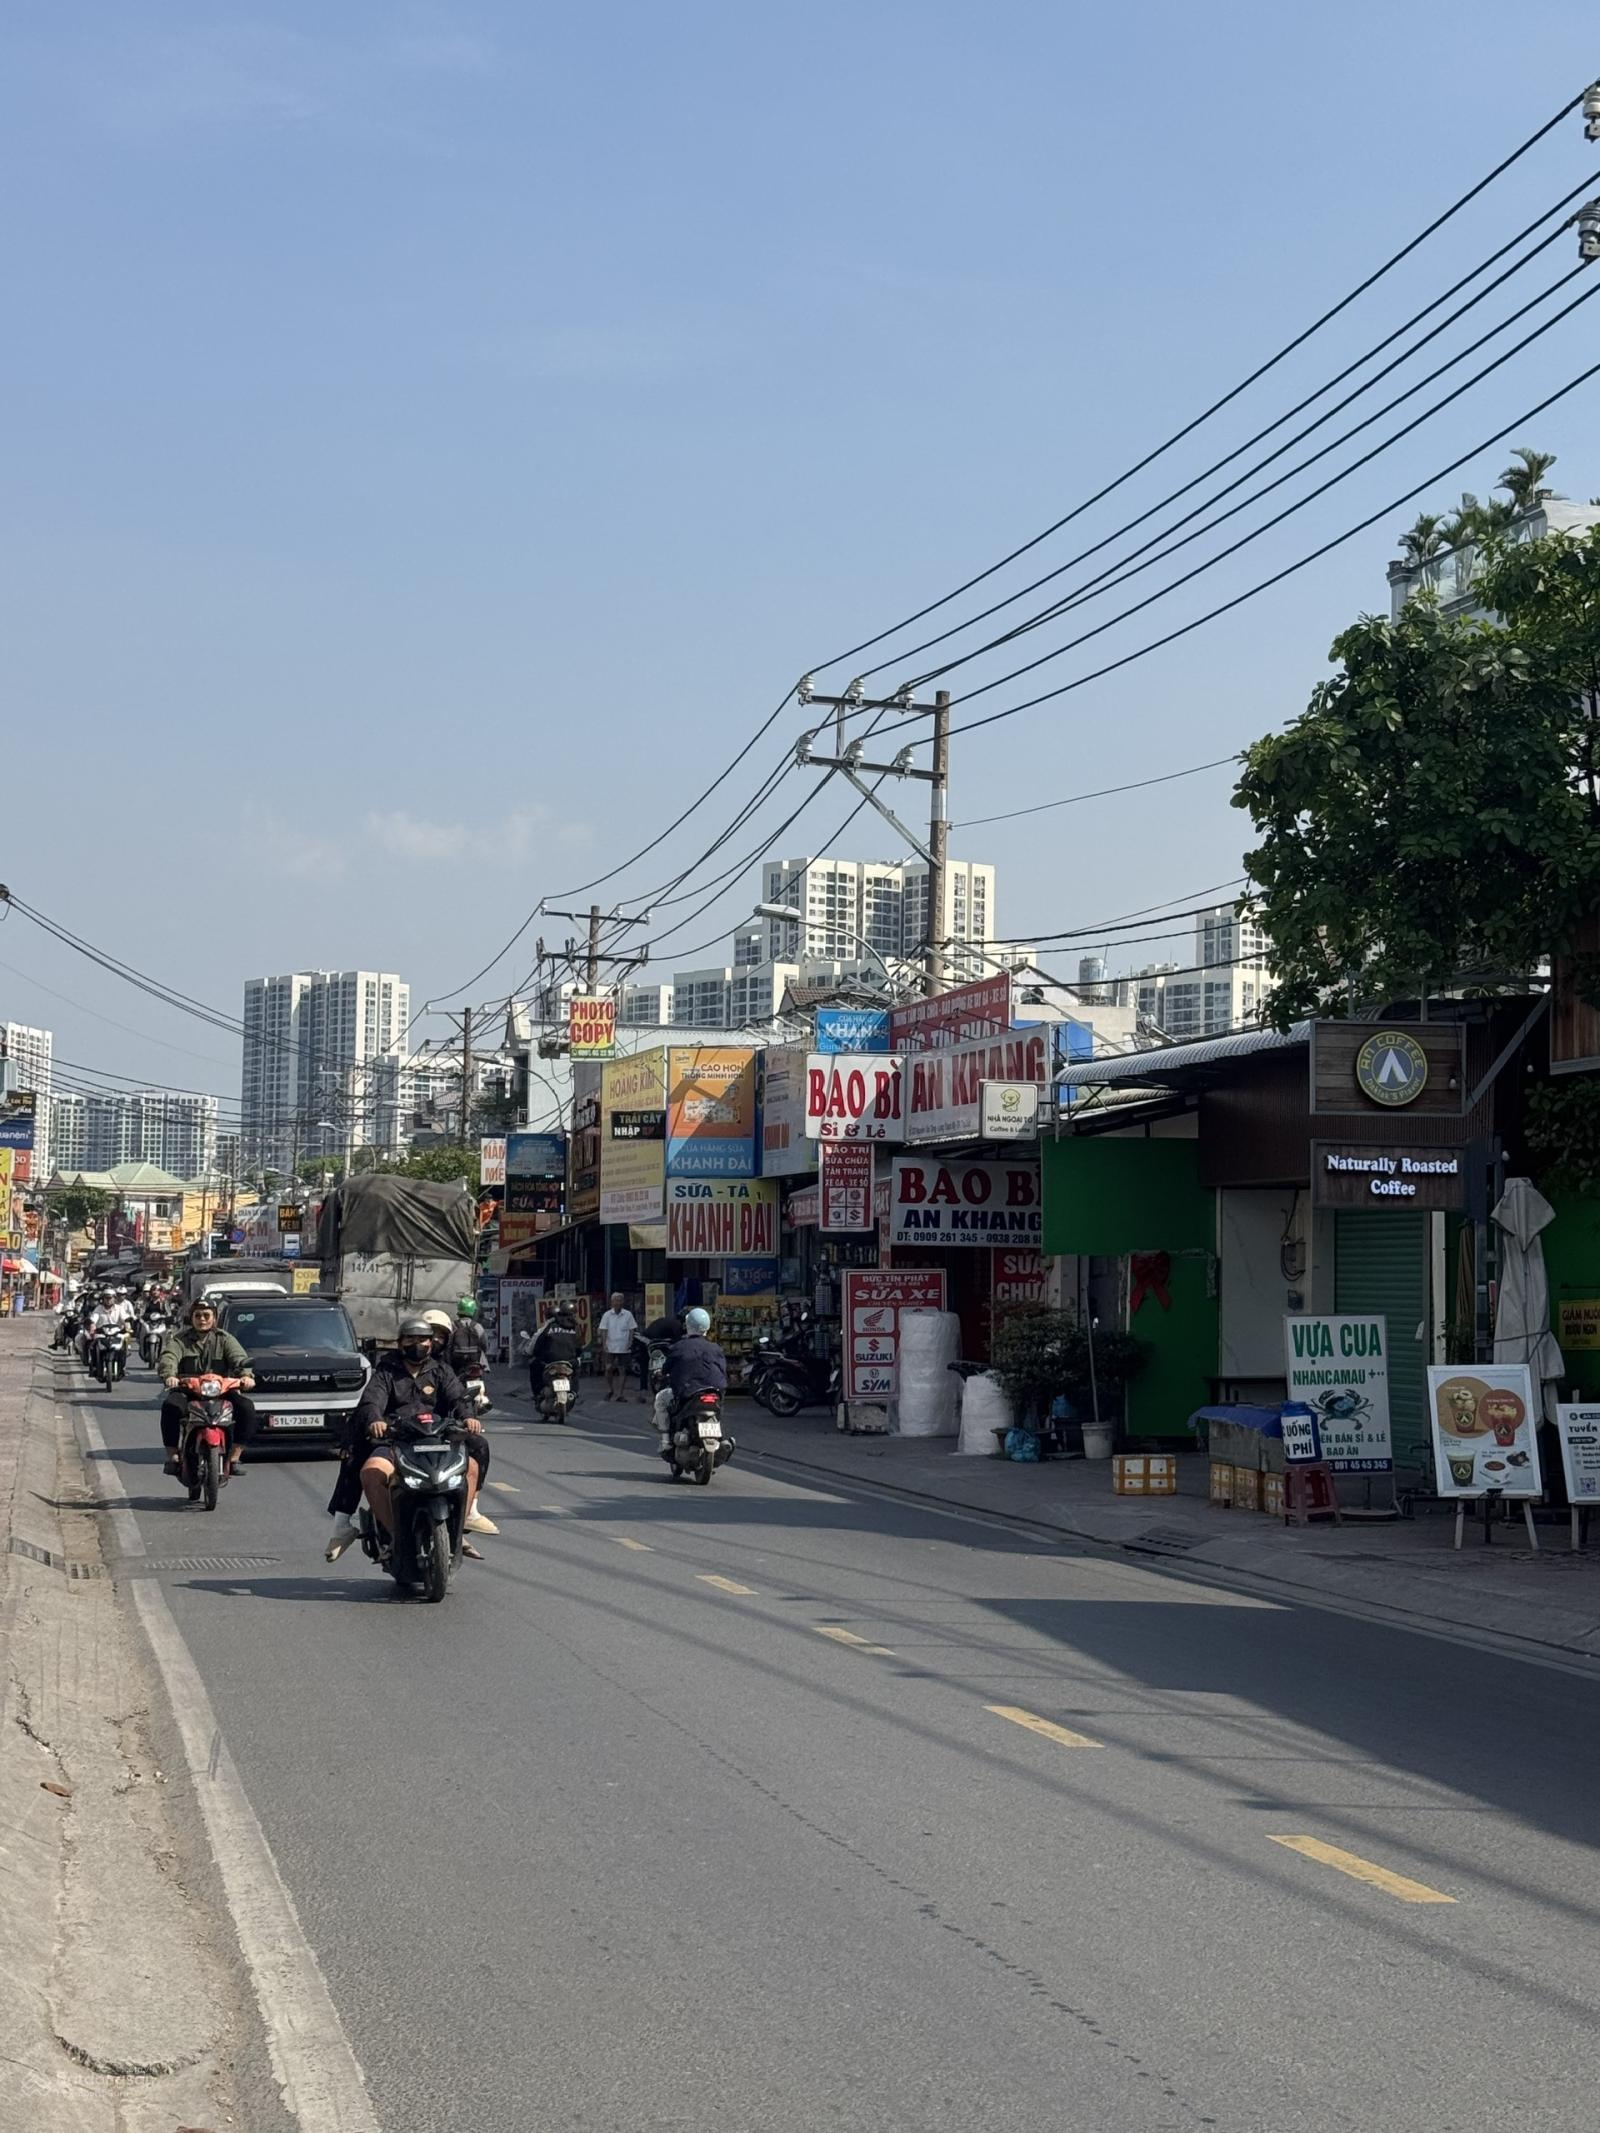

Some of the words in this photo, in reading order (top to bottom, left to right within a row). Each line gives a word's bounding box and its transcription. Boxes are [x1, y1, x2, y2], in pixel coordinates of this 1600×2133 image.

[570, 1001, 614, 1020] PHOTO
[571, 1022, 614, 1044] COPY
[1375, 1035, 1425, 1068] COFFEE
[701, 1064, 721, 1072] CAO
[911, 1058, 944, 1114] AN
[951, 1036, 1047, 1107] KHANG
[609, 1072, 638, 1100] HOÀNG
[808, 1068, 866, 1118] BAO
[874, 1058, 902, 1120] BÌ
[642, 1112, 662, 1124] CÂY
[987, 1114, 1001, 1122] NHÀ
[614, 1125, 641, 1139] NHẬP
[844, 1123, 860, 1138] &
[671, 1157, 723, 1170] KHANH
[1326, 1155, 1397, 1175] Naturally
[1401, 1158, 1459, 1174] Roasted
[843, 1167, 869, 1176] TRANG
[674, 1183, 713, 1198] SỮA
[727, 1184, 750, 1198] TÃ
[898, 1167, 992, 1206] BAO
[1370, 1179, 1416, 1196] Coffee
[668, 1202, 735, 1253] KHANH
[740, 1190, 773, 1253] ĐÀI
[903, 1209, 941, 1229] AN
[951, 1210, 1041, 1231] KHANG
[913, 1232, 938, 1242] 0909
[940, 1232, 956, 1242] 261
[960, 1232, 978, 1243] 345
[986, 1233, 1010, 1244] 0938
[1012, 1233, 1030, 1244] 208
[351, 1262, 380, 1273] 147.41
[743, 1268, 774, 1284] Tiger
[904, 1274, 931, 1283] PHÁT
[501, 1280, 544, 1288] CERAGEM
[854, 1286, 902, 1300] SỬA
[908, 1288, 941, 1300] XE
[1292, 1321, 1335, 1365] VỰA
[1340, 1323, 1383, 1357] CUA
[855, 1353, 893, 1361] SUZUKI
[262, 1374, 331, 1382] VINFAST
[1292, 1368, 1366, 1386] NHANCAMAU
[861, 1379, 891, 1392] SYM
[1286, 1419, 1311, 1437] UỐNG
[1335, 1431, 1353, 1443] BÁN
[1367, 1432, 1374, 1442] &
[1292, 1439, 1313, 1455] PHÍ
[1326, 1446, 1344, 1456] BAO
[1334, 1460, 1348, 1470] 091
[1351, 1460, 1360, 1470] 45
